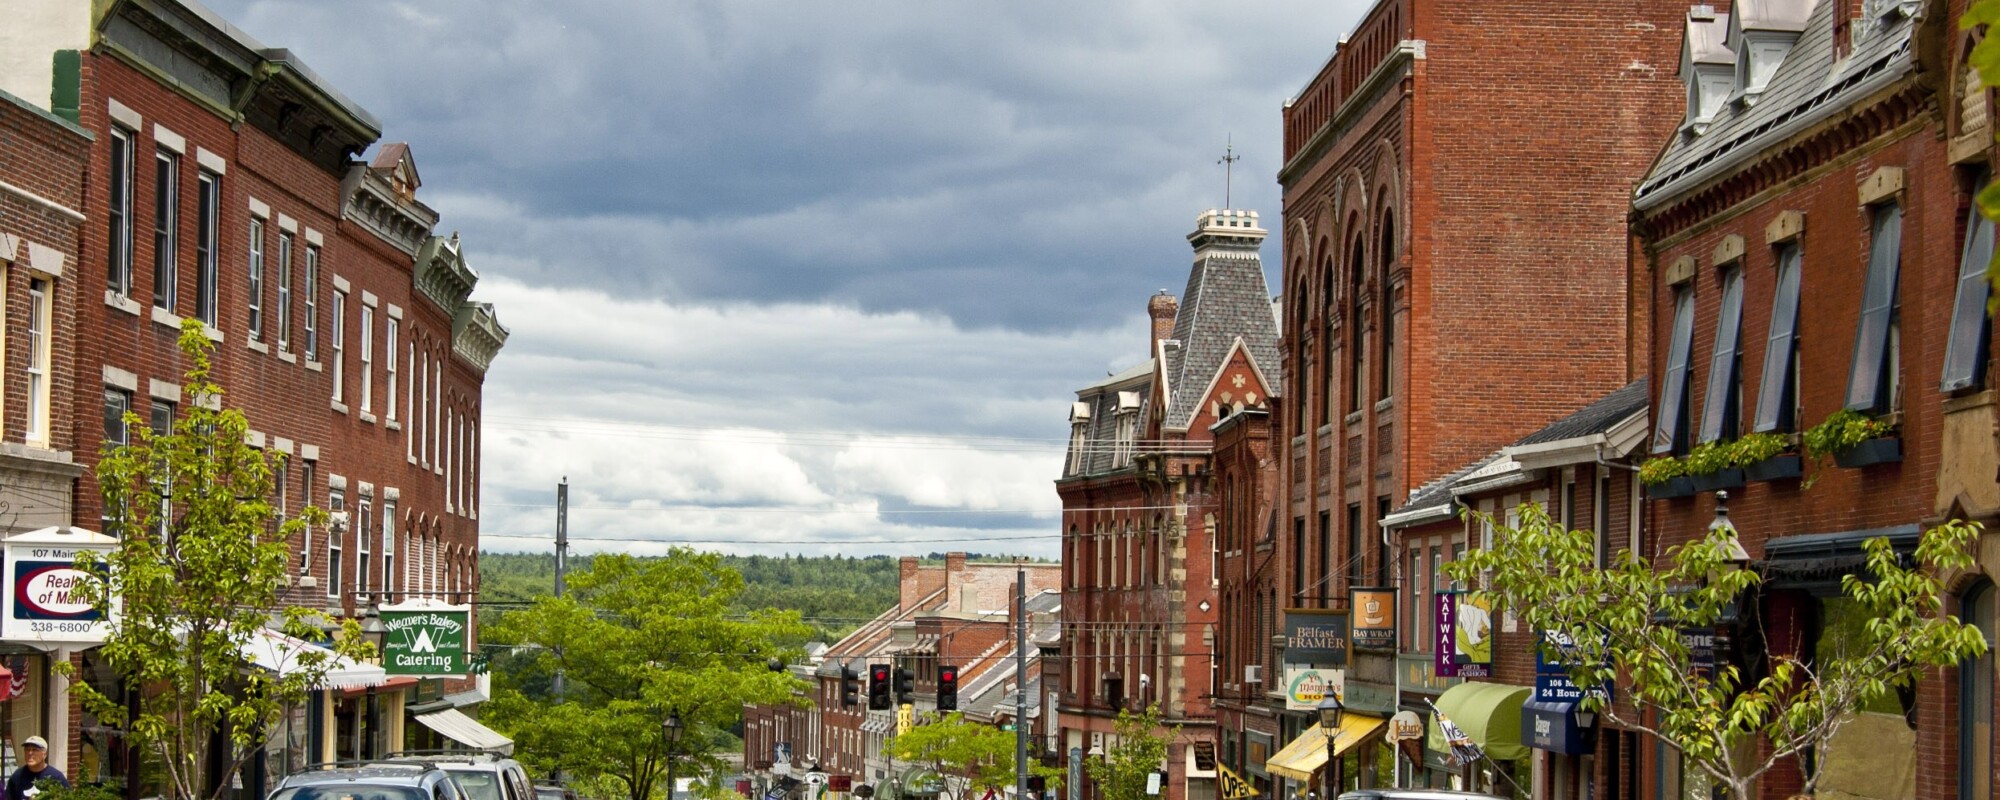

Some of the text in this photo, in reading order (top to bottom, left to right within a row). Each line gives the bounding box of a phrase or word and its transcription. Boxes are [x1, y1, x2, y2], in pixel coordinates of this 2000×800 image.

[32, 549, 49, 558] 107
[38, 591, 53, 604] of
[31, 622, 90, 632] 338-6800
[384, 613, 463, 635] Weaver's Bakery
[1440, 593, 1451, 665] KATWALK
[1297, 627, 1335, 638] Belfast
[1353, 629, 1394, 638] BAY WRAP
[1288, 637, 1346, 648] FRAMER
[396, 653, 452, 672] Catering
[1457, 669, 1488, 677] FASHION
[1549, 679, 1562, 687] 106
[1542, 689, 1553, 697] 24
[1556, 689, 1581, 697] Hour
[1391, 720, 1423, 740] John's
[1222, 770, 1251, 798] OPEN
